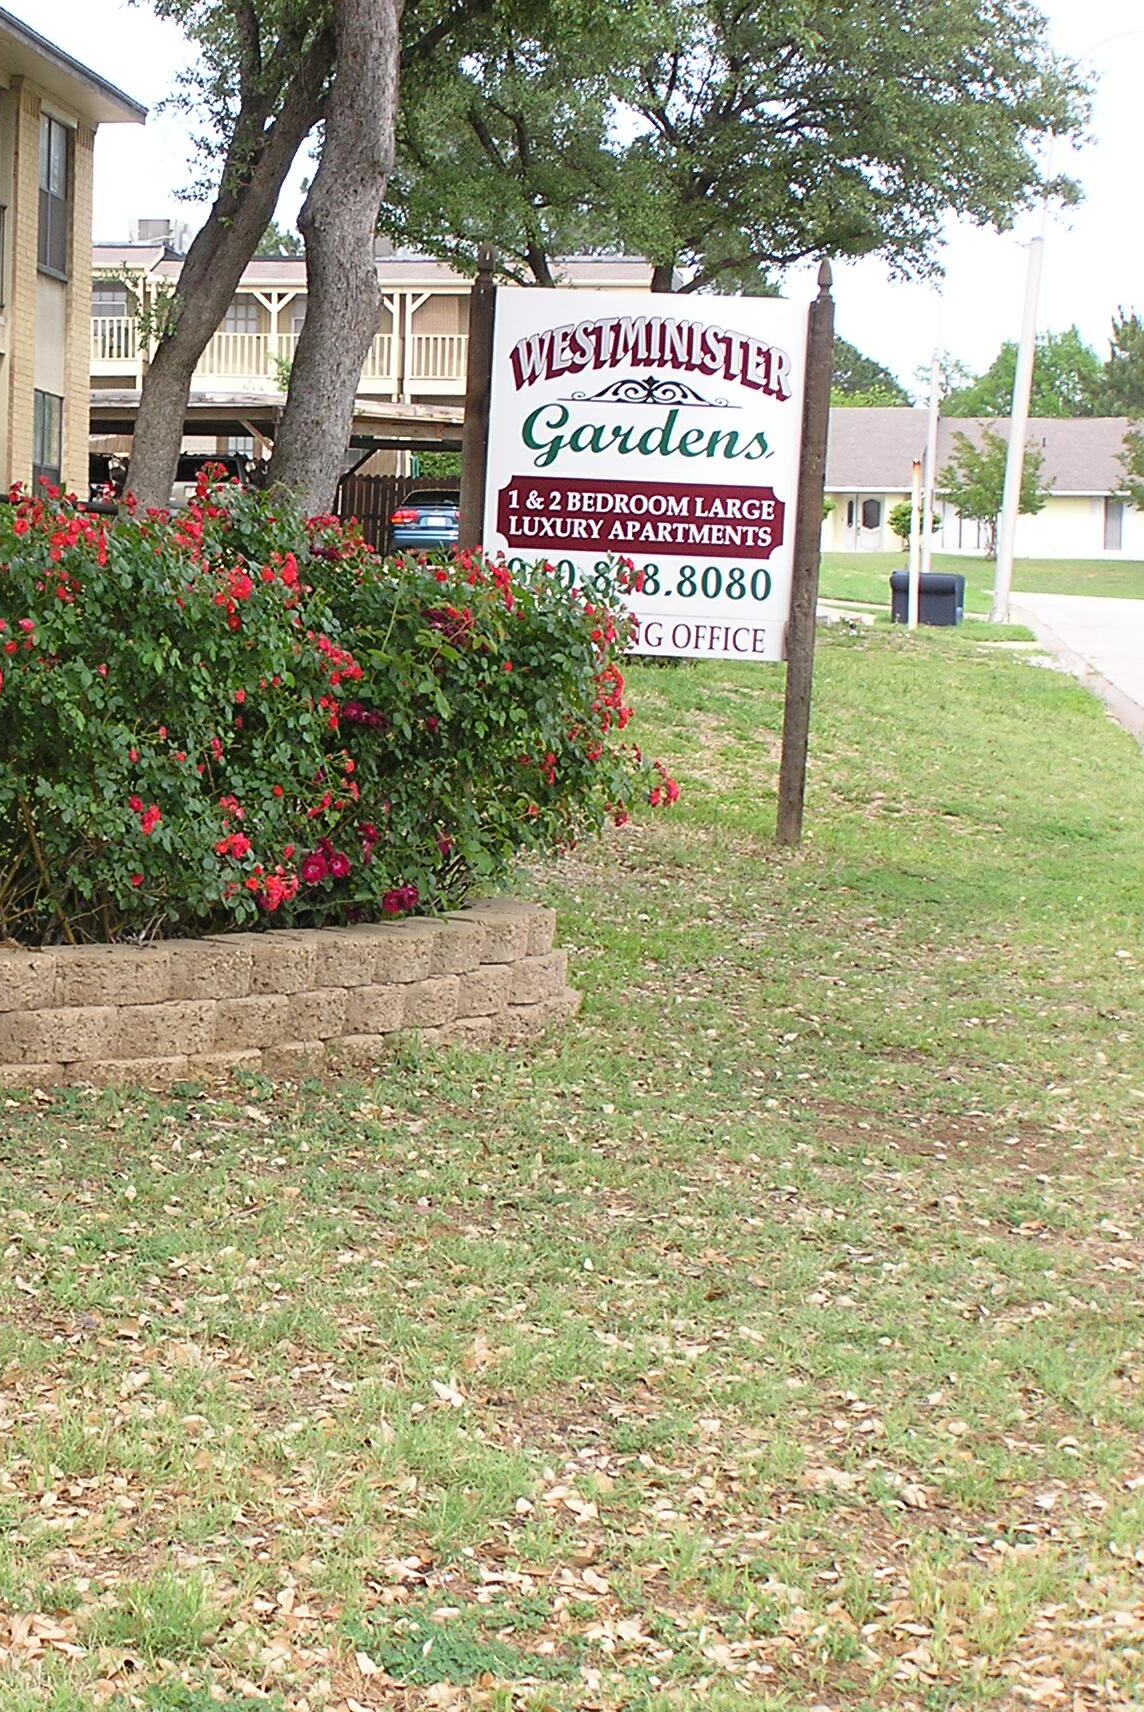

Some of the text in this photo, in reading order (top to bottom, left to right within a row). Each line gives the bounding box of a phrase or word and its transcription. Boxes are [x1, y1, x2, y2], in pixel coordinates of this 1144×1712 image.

[508, 316, 793, 402] WESTMINISTER
[522, 403, 769, 467] Gardens
[508, 489, 776, 521] 1 & 2 BEDROOM LARGE
[508, 515, 773, 547] LUXURY APARTMENTS
[671, 622, 767, 655] OFFICE
